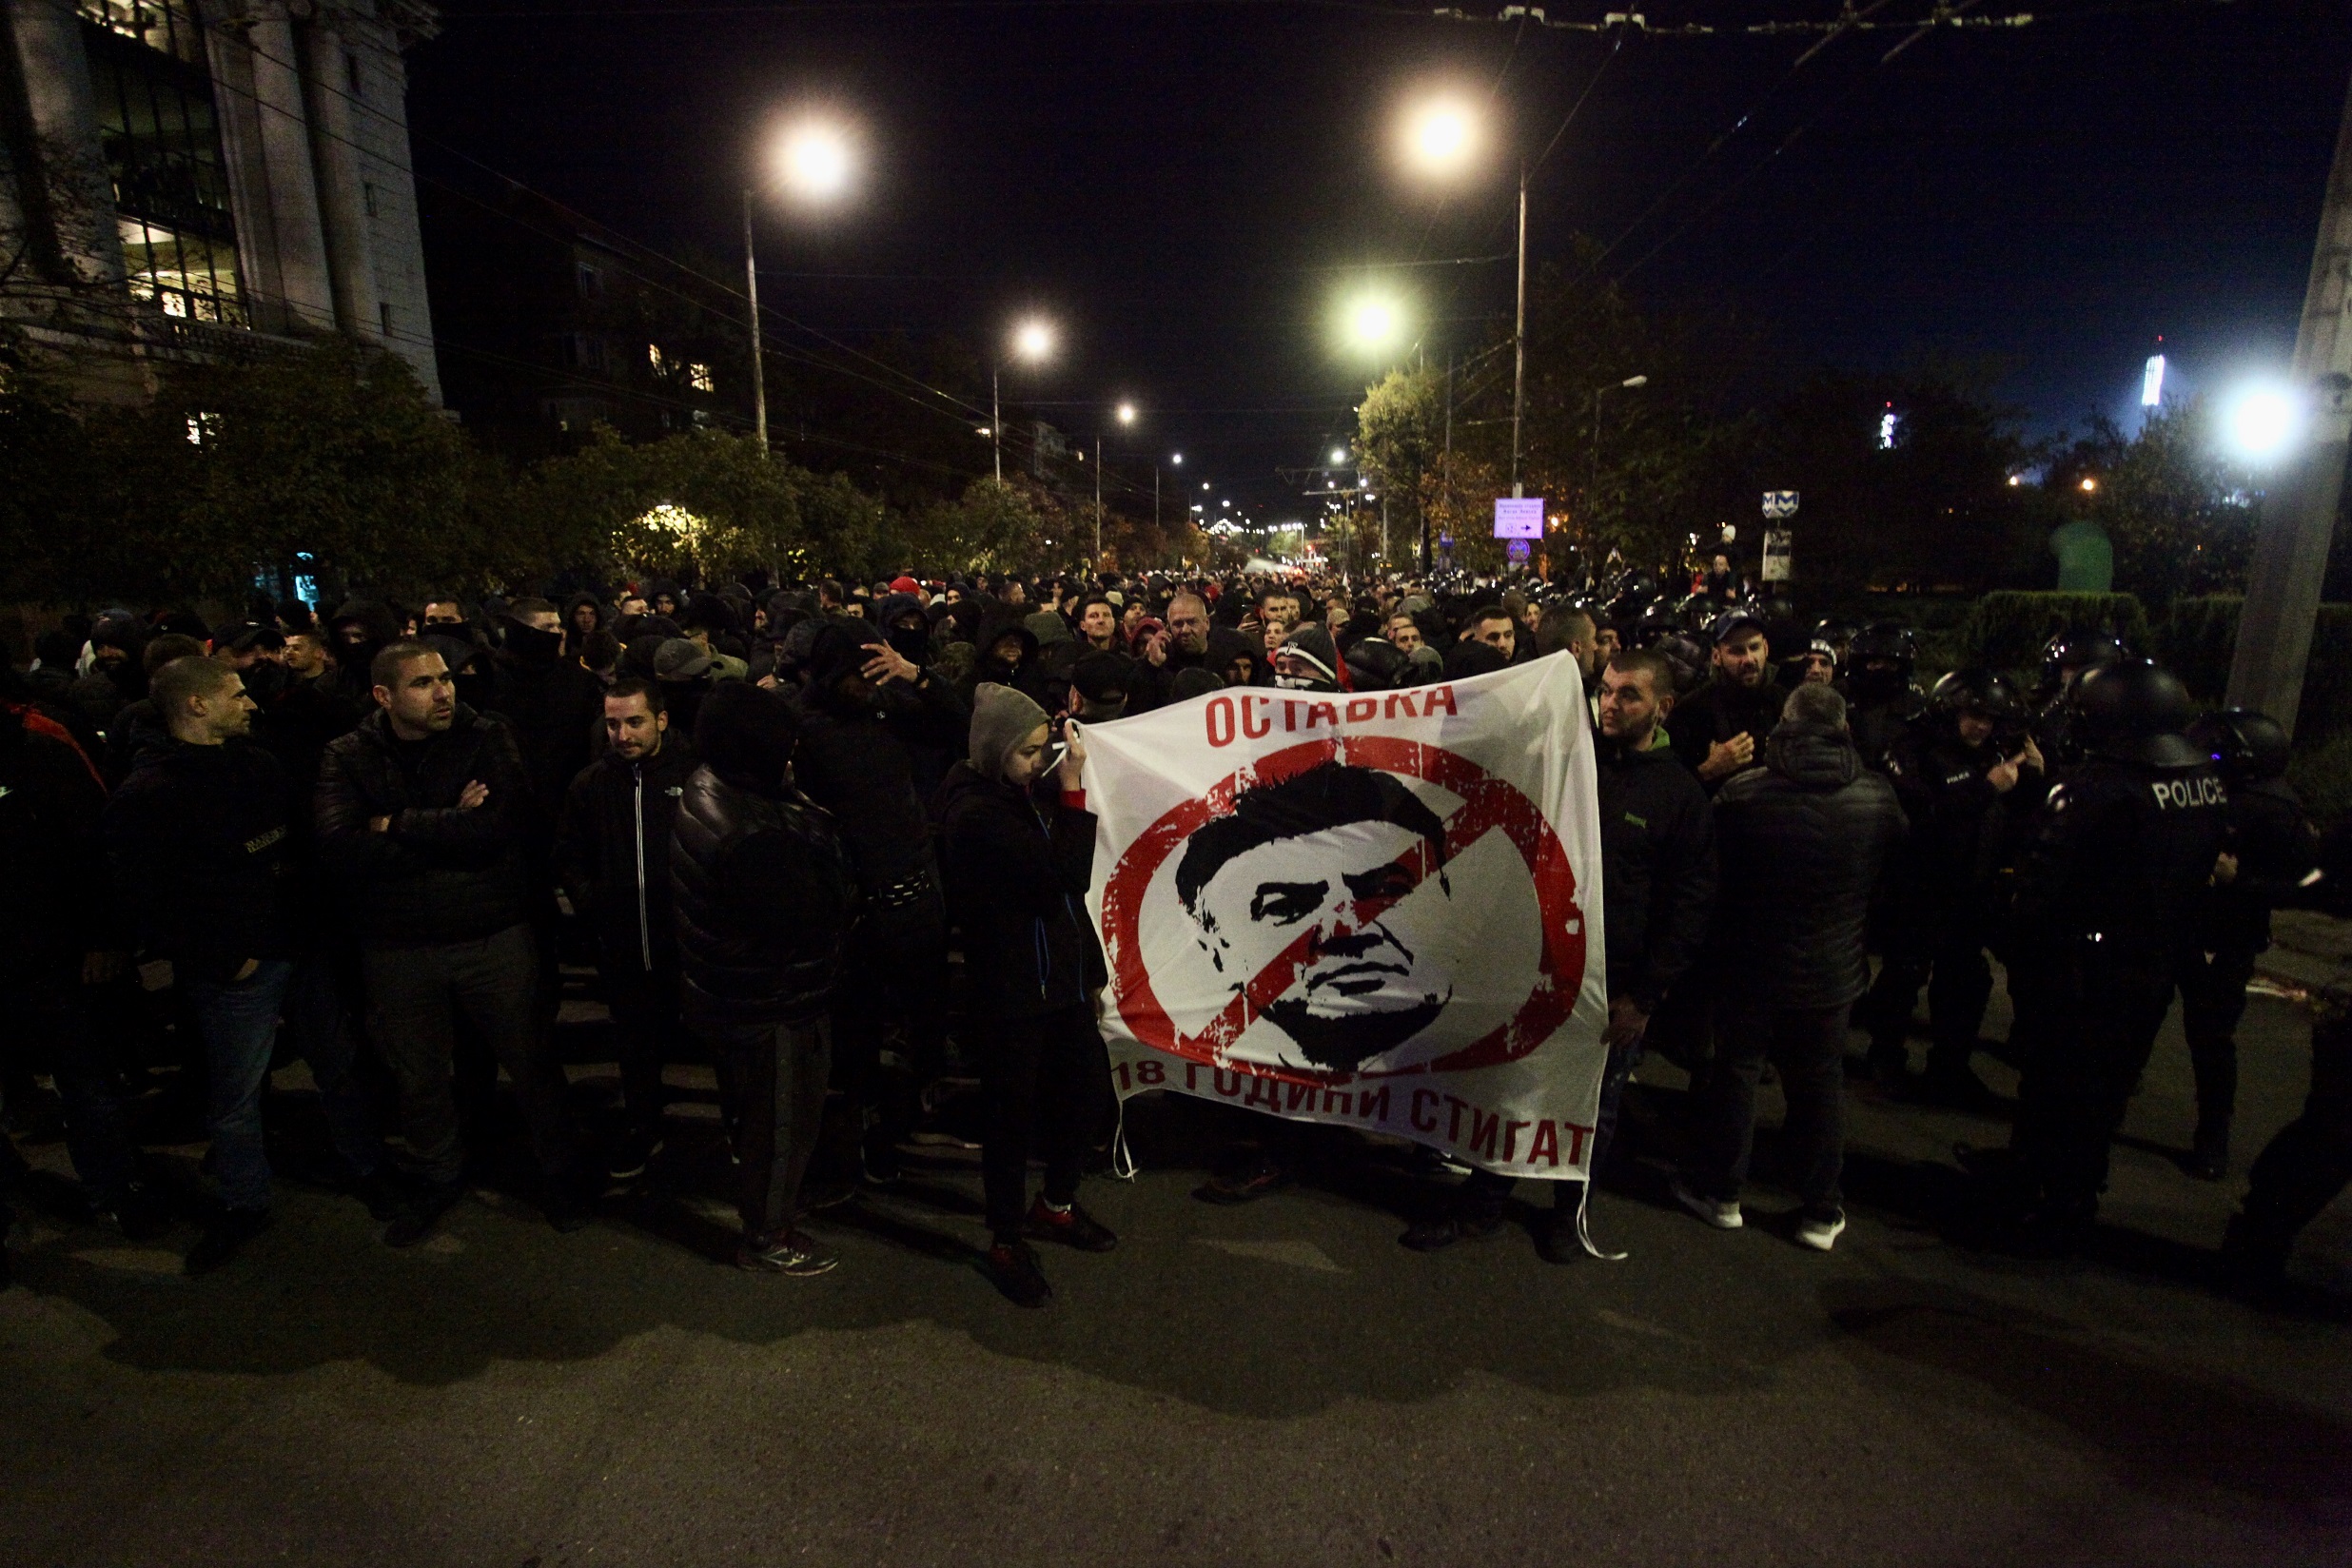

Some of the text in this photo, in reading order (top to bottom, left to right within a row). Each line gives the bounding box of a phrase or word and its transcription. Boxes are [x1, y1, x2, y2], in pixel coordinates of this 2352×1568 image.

[2151, 776, 2228, 810] POLICE
[1111, 1060, 1166, 1091] 18
[1410, 1088, 1595, 1166] СТИГАТ
